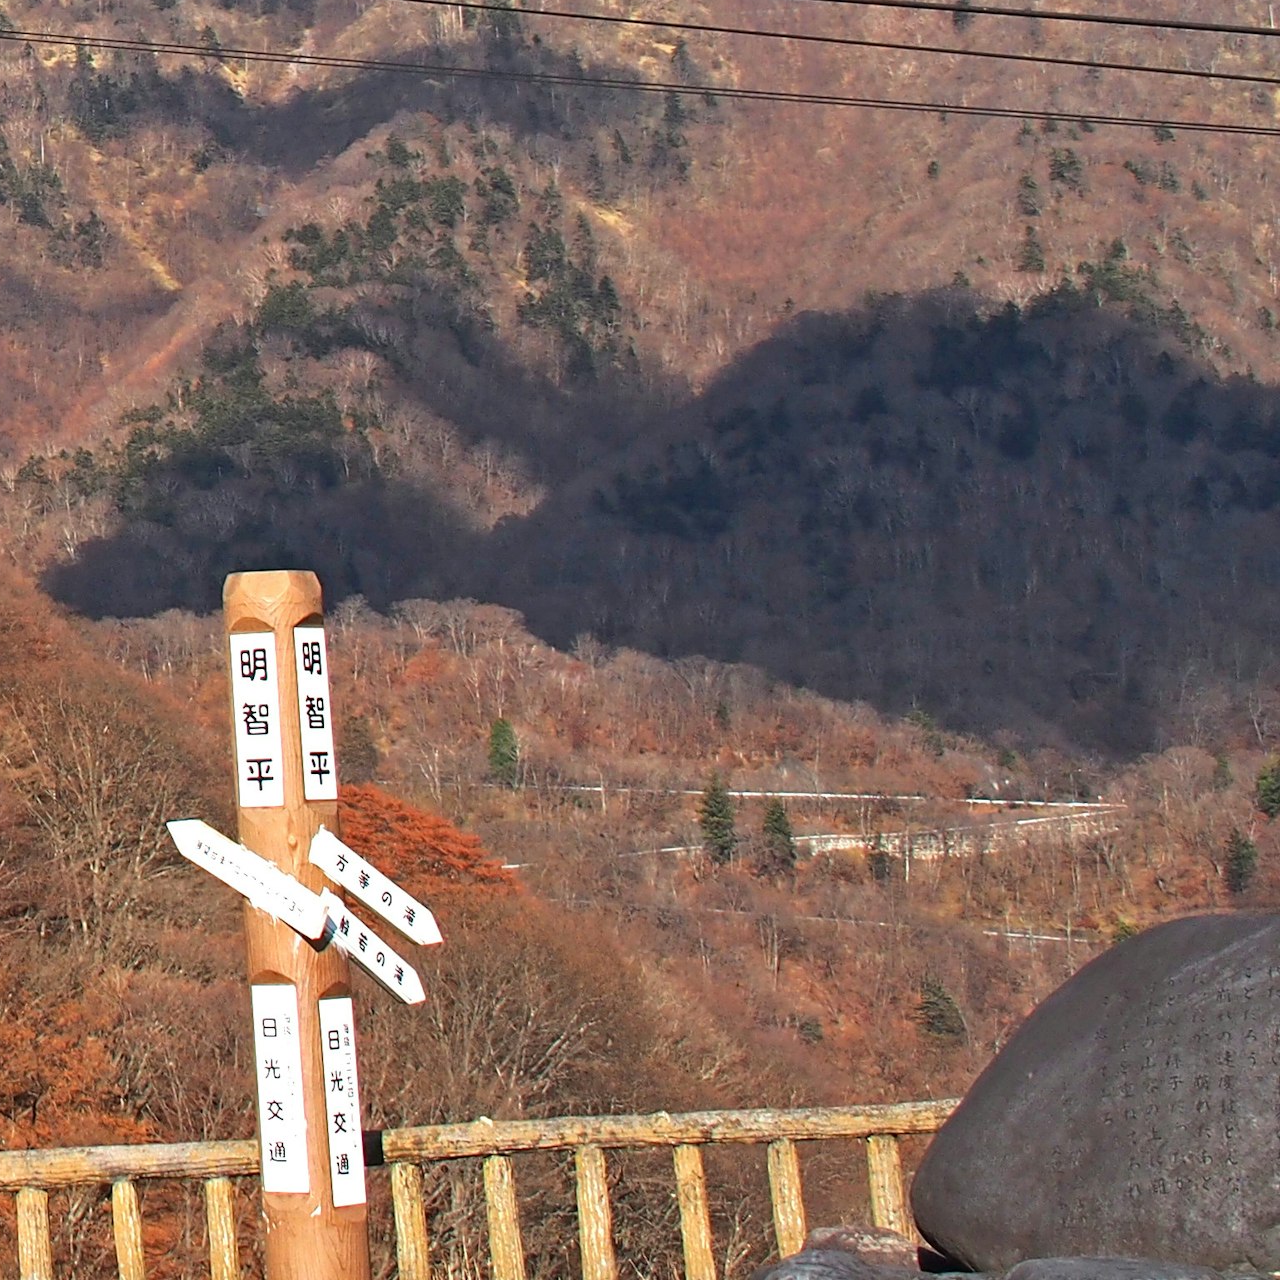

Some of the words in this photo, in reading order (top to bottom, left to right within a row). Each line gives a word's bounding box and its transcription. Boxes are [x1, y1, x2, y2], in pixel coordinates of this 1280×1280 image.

[240, 648, 274, 792] 明智平
[302, 642, 330, 786] 明智平
[262, 1017, 287, 1163] 日光交通
[327, 1029, 350, 1176] 日光交通
